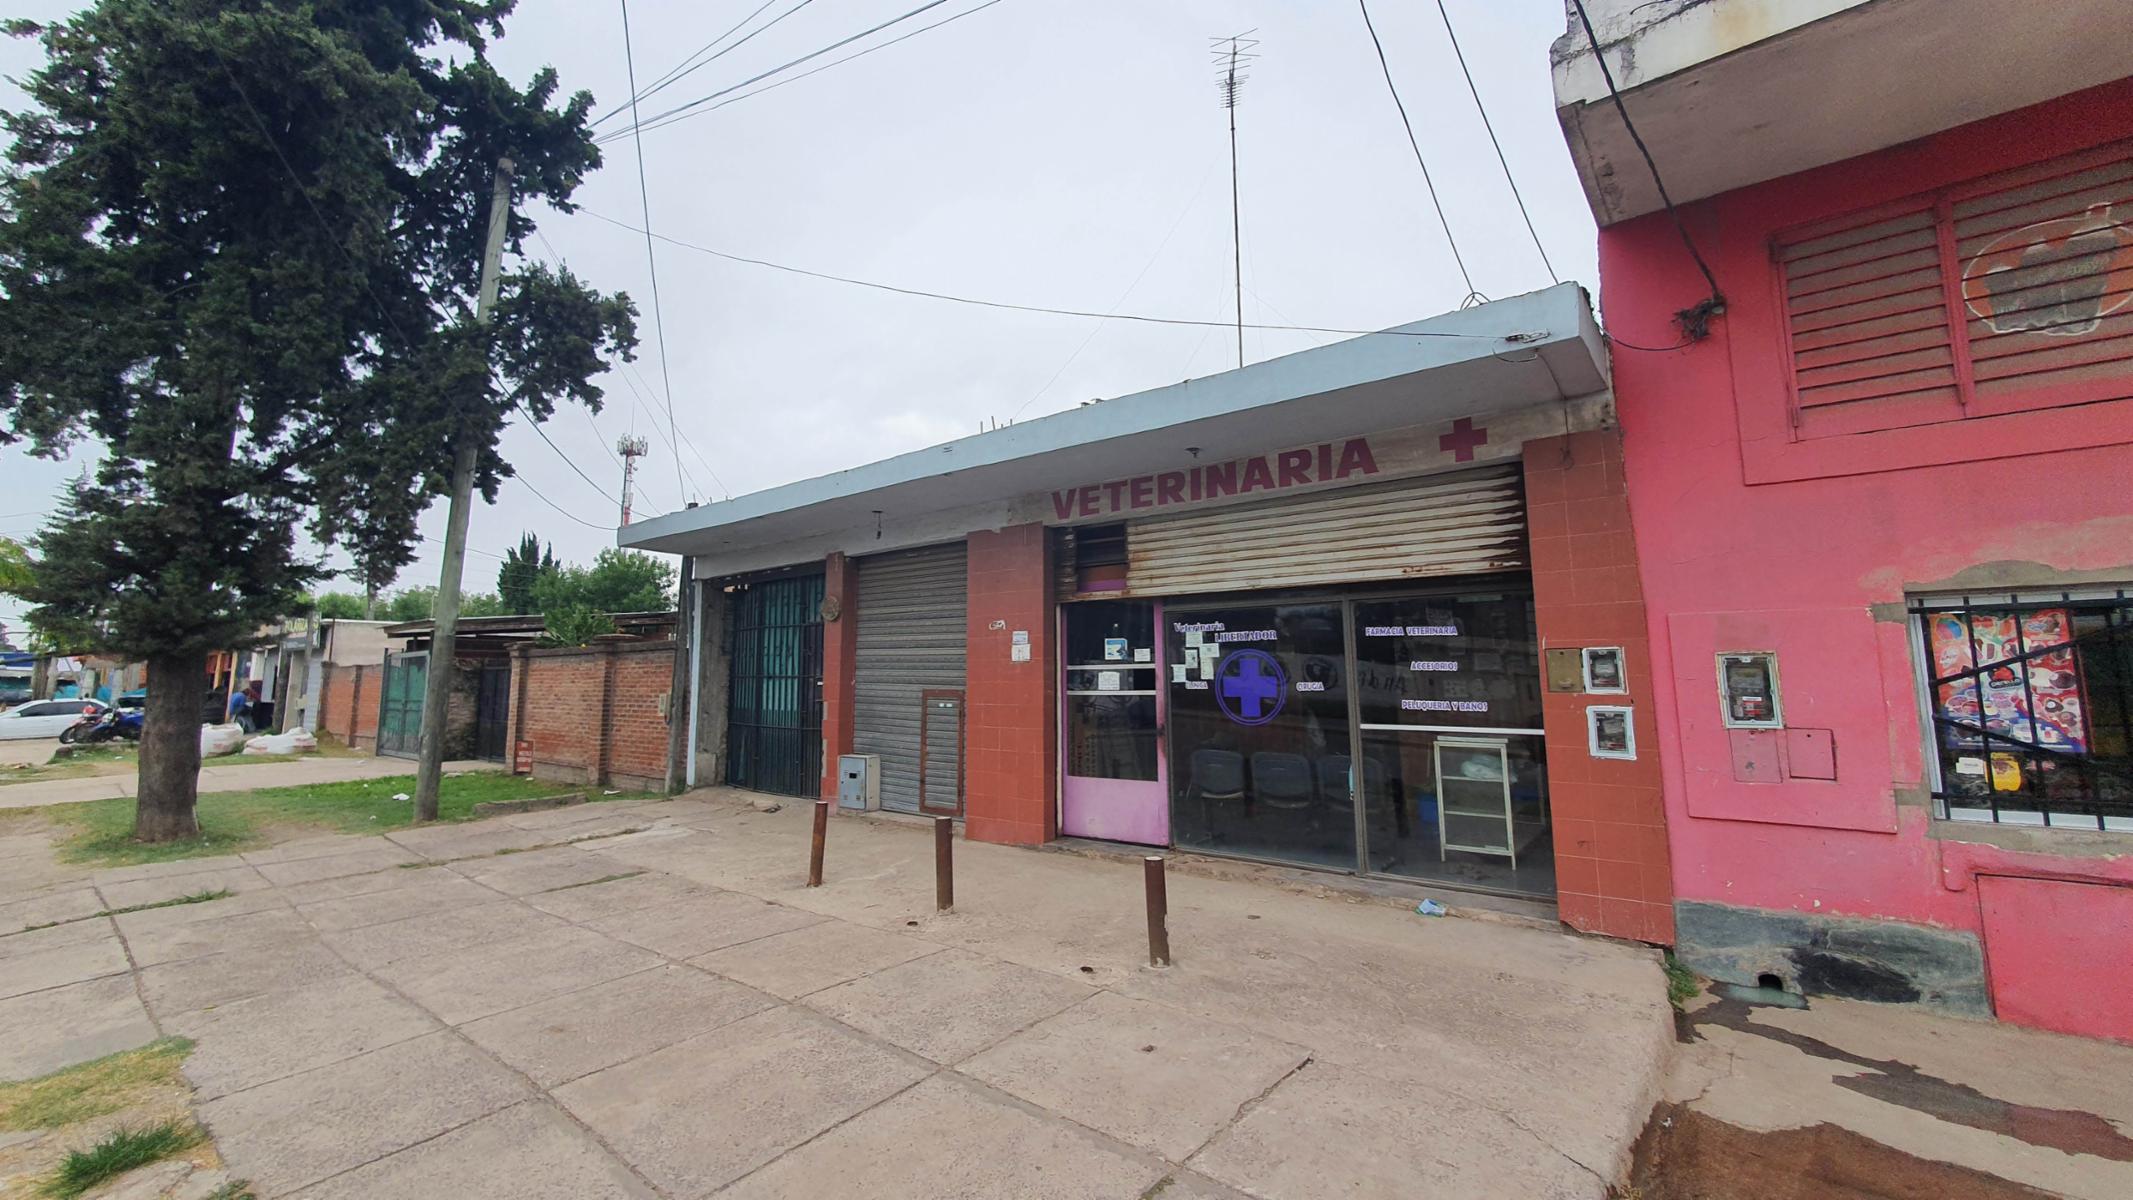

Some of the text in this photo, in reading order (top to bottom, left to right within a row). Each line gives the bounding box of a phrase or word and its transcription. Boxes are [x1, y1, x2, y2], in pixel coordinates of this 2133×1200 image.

[1052, 438, 1378, 520] VETERINARIA
[1173, 621, 1225, 633] Veterinaria
[1365, 625, 1458, 636] FARMACIA VETERINARIA
[1215, 630, 1277, 642] LIBERTADOR
[1410, 661, 1458, 671] ACCESORIOS
[1401, 699, 1451, 711] PELUQUERIA
[1451, 701, 1458, 711] Y
